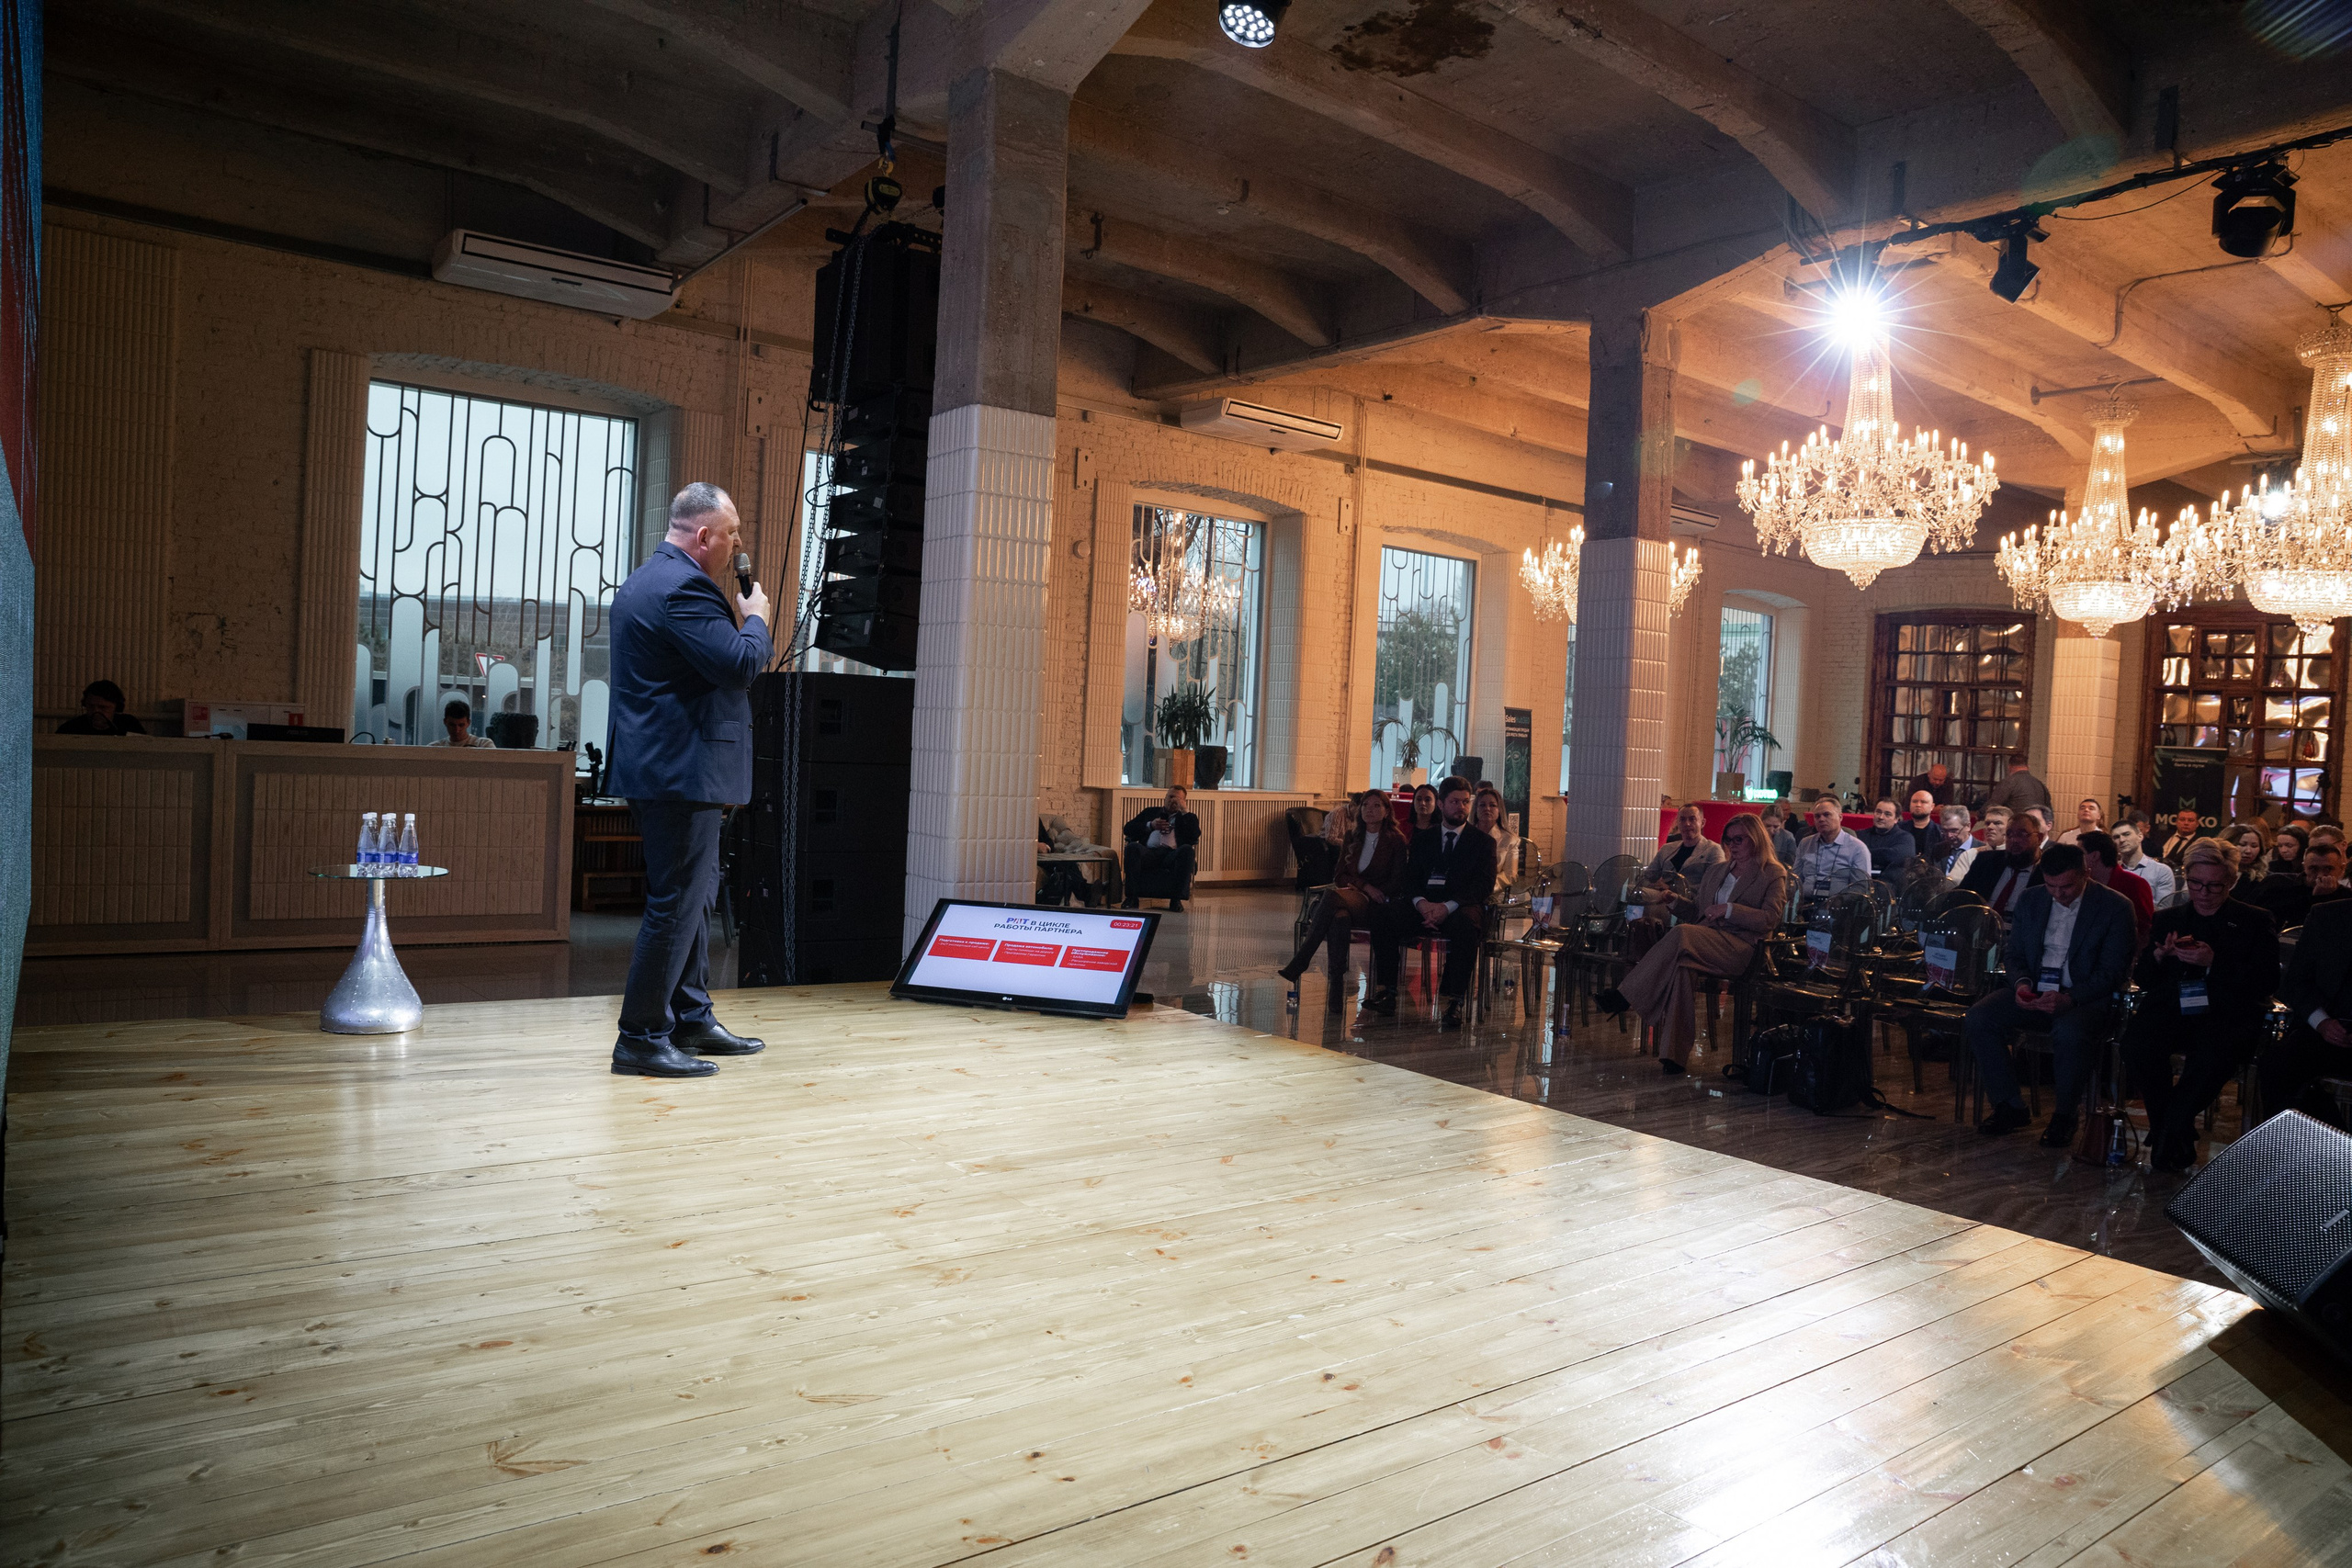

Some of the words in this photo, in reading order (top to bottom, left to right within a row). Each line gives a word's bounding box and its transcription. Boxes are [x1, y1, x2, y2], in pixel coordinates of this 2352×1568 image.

[993, 923, 1033, 931] РАБОТЫ
[1034, 926, 1083, 935] ПАРТНЕРА
[1038, 920, 1071, 929] ЦИКЛЕ
